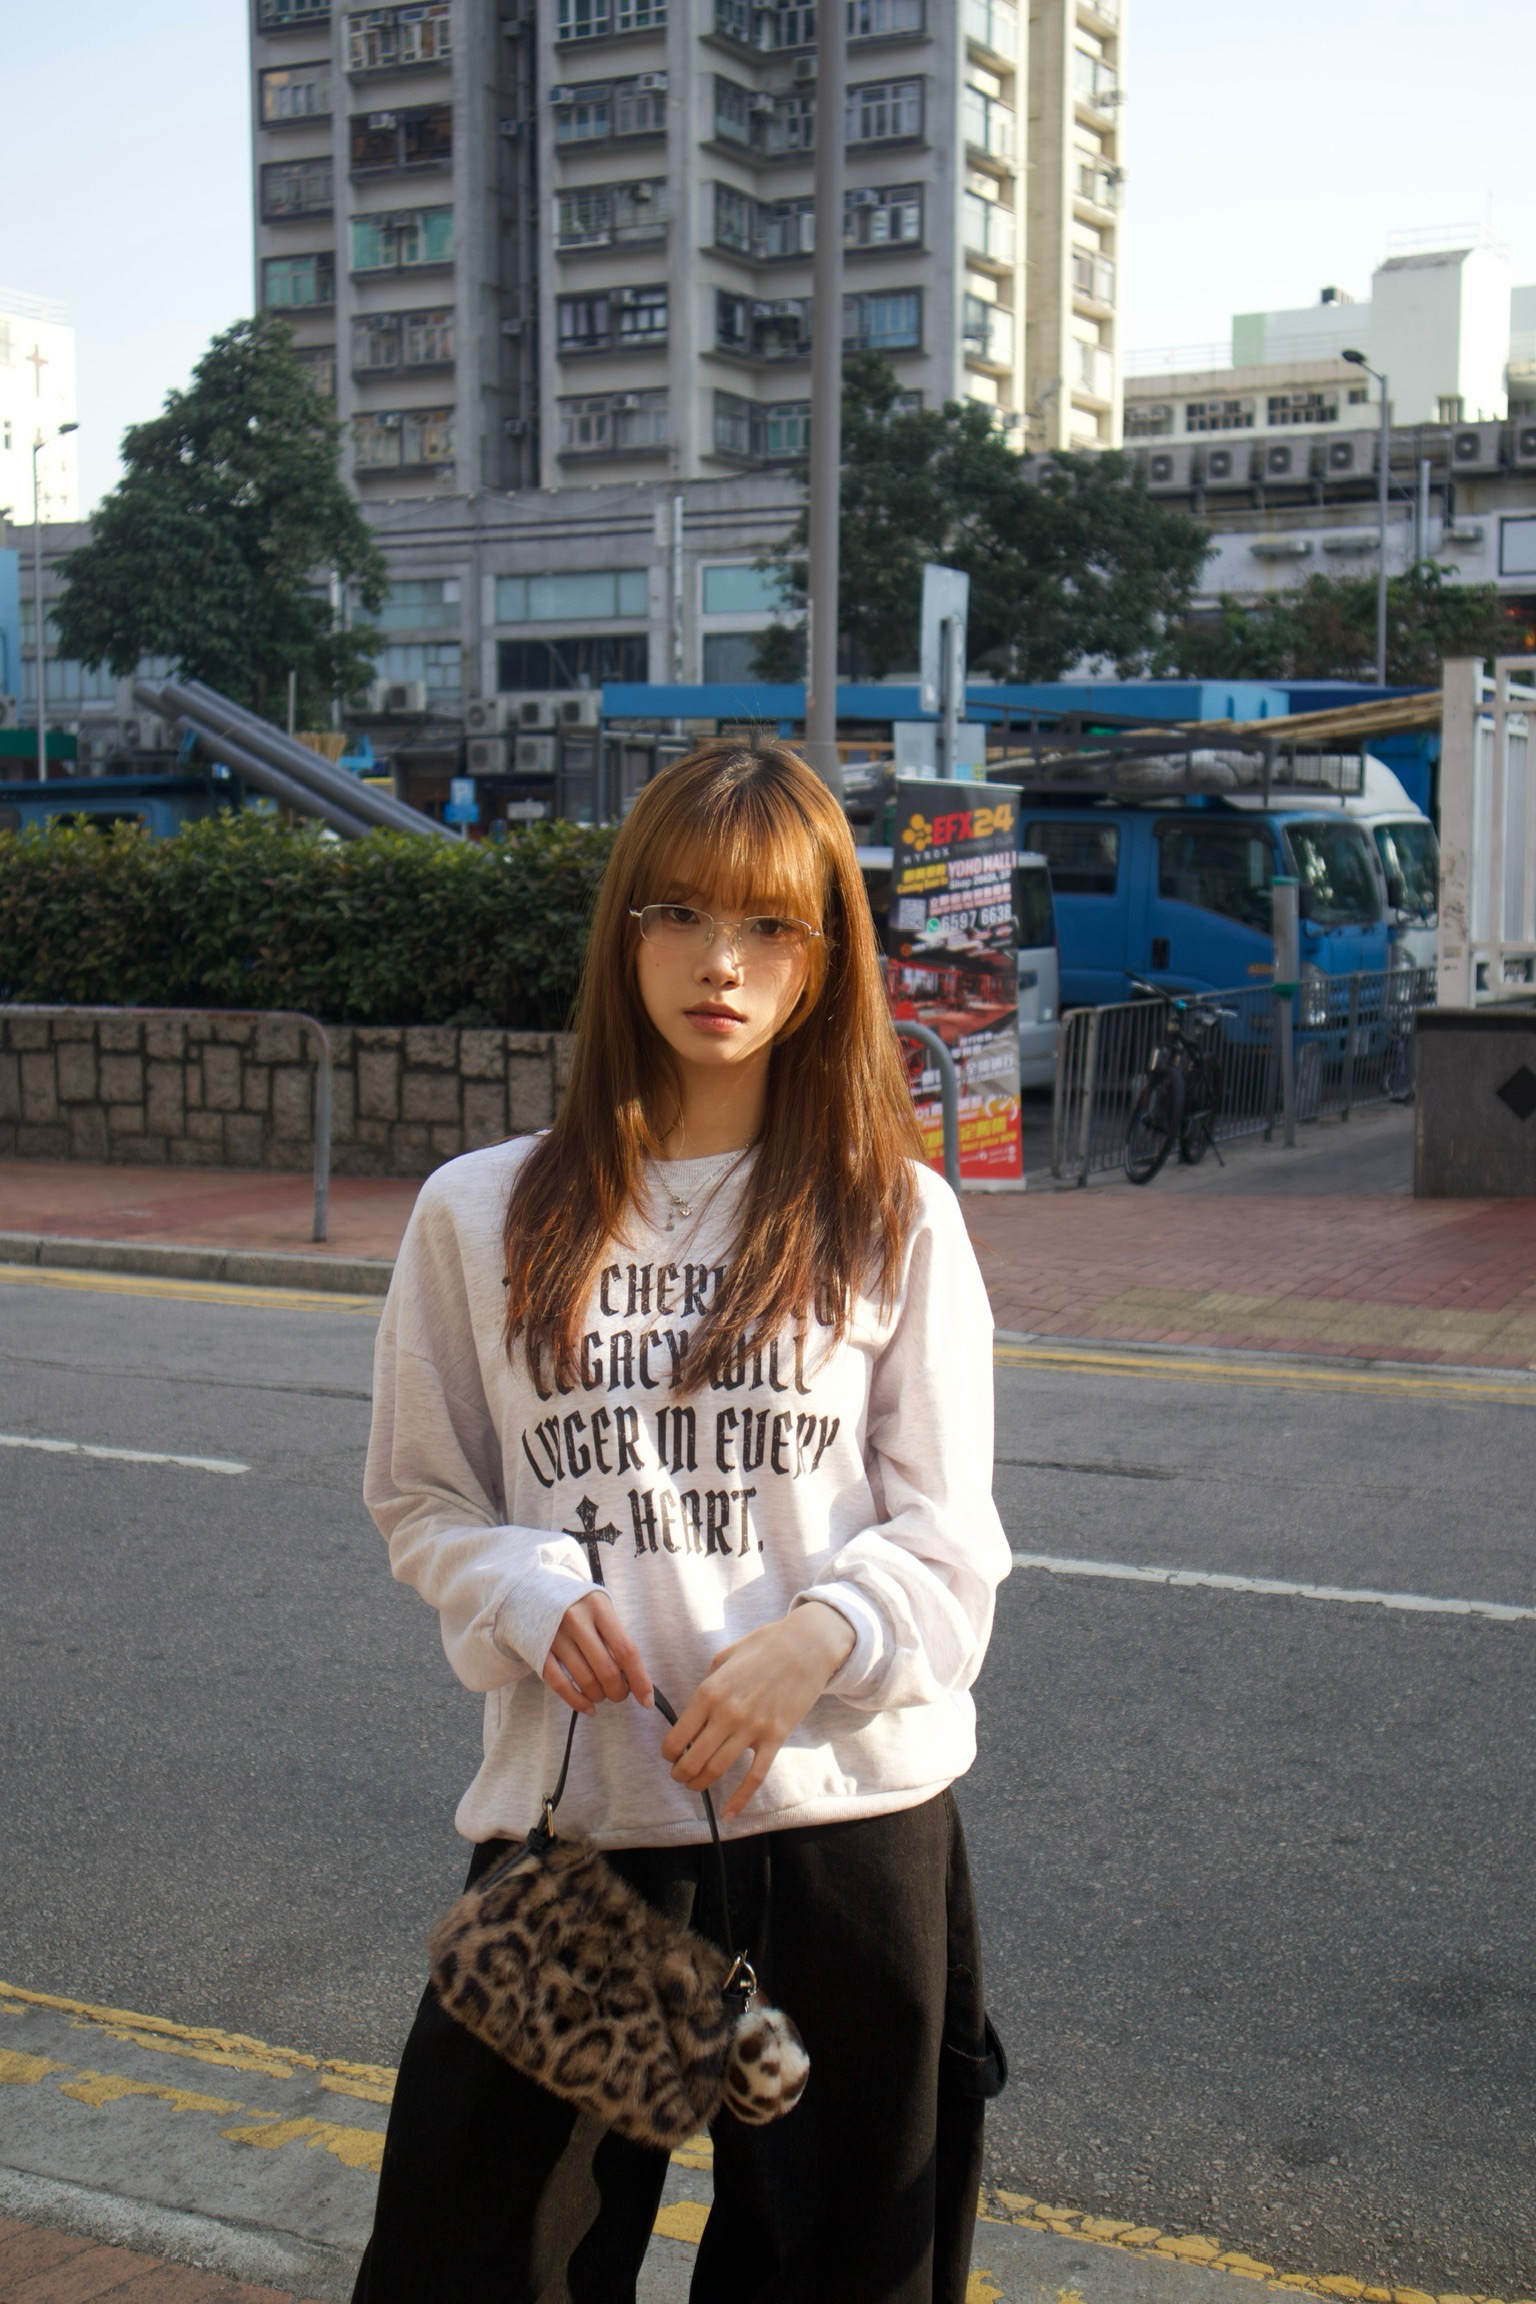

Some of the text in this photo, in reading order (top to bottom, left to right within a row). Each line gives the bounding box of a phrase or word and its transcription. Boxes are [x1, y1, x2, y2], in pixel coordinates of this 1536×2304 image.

[932, 803, 1015, 846] EFX24
[903, 846, 950, 865] HYROX
[946, 857, 982, 880] YOHO
[983, 851, 1011, 874] MALL
[949, 878, 972, 890] Shop
[941, 909, 977, 933] 6597
[981, 902, 1012, 926] 6638
[522, 1405, 645, 1489] LINGER
[655, 1405, 698, 1475] IN
[627, 1487, 764, 1558] HEART.
